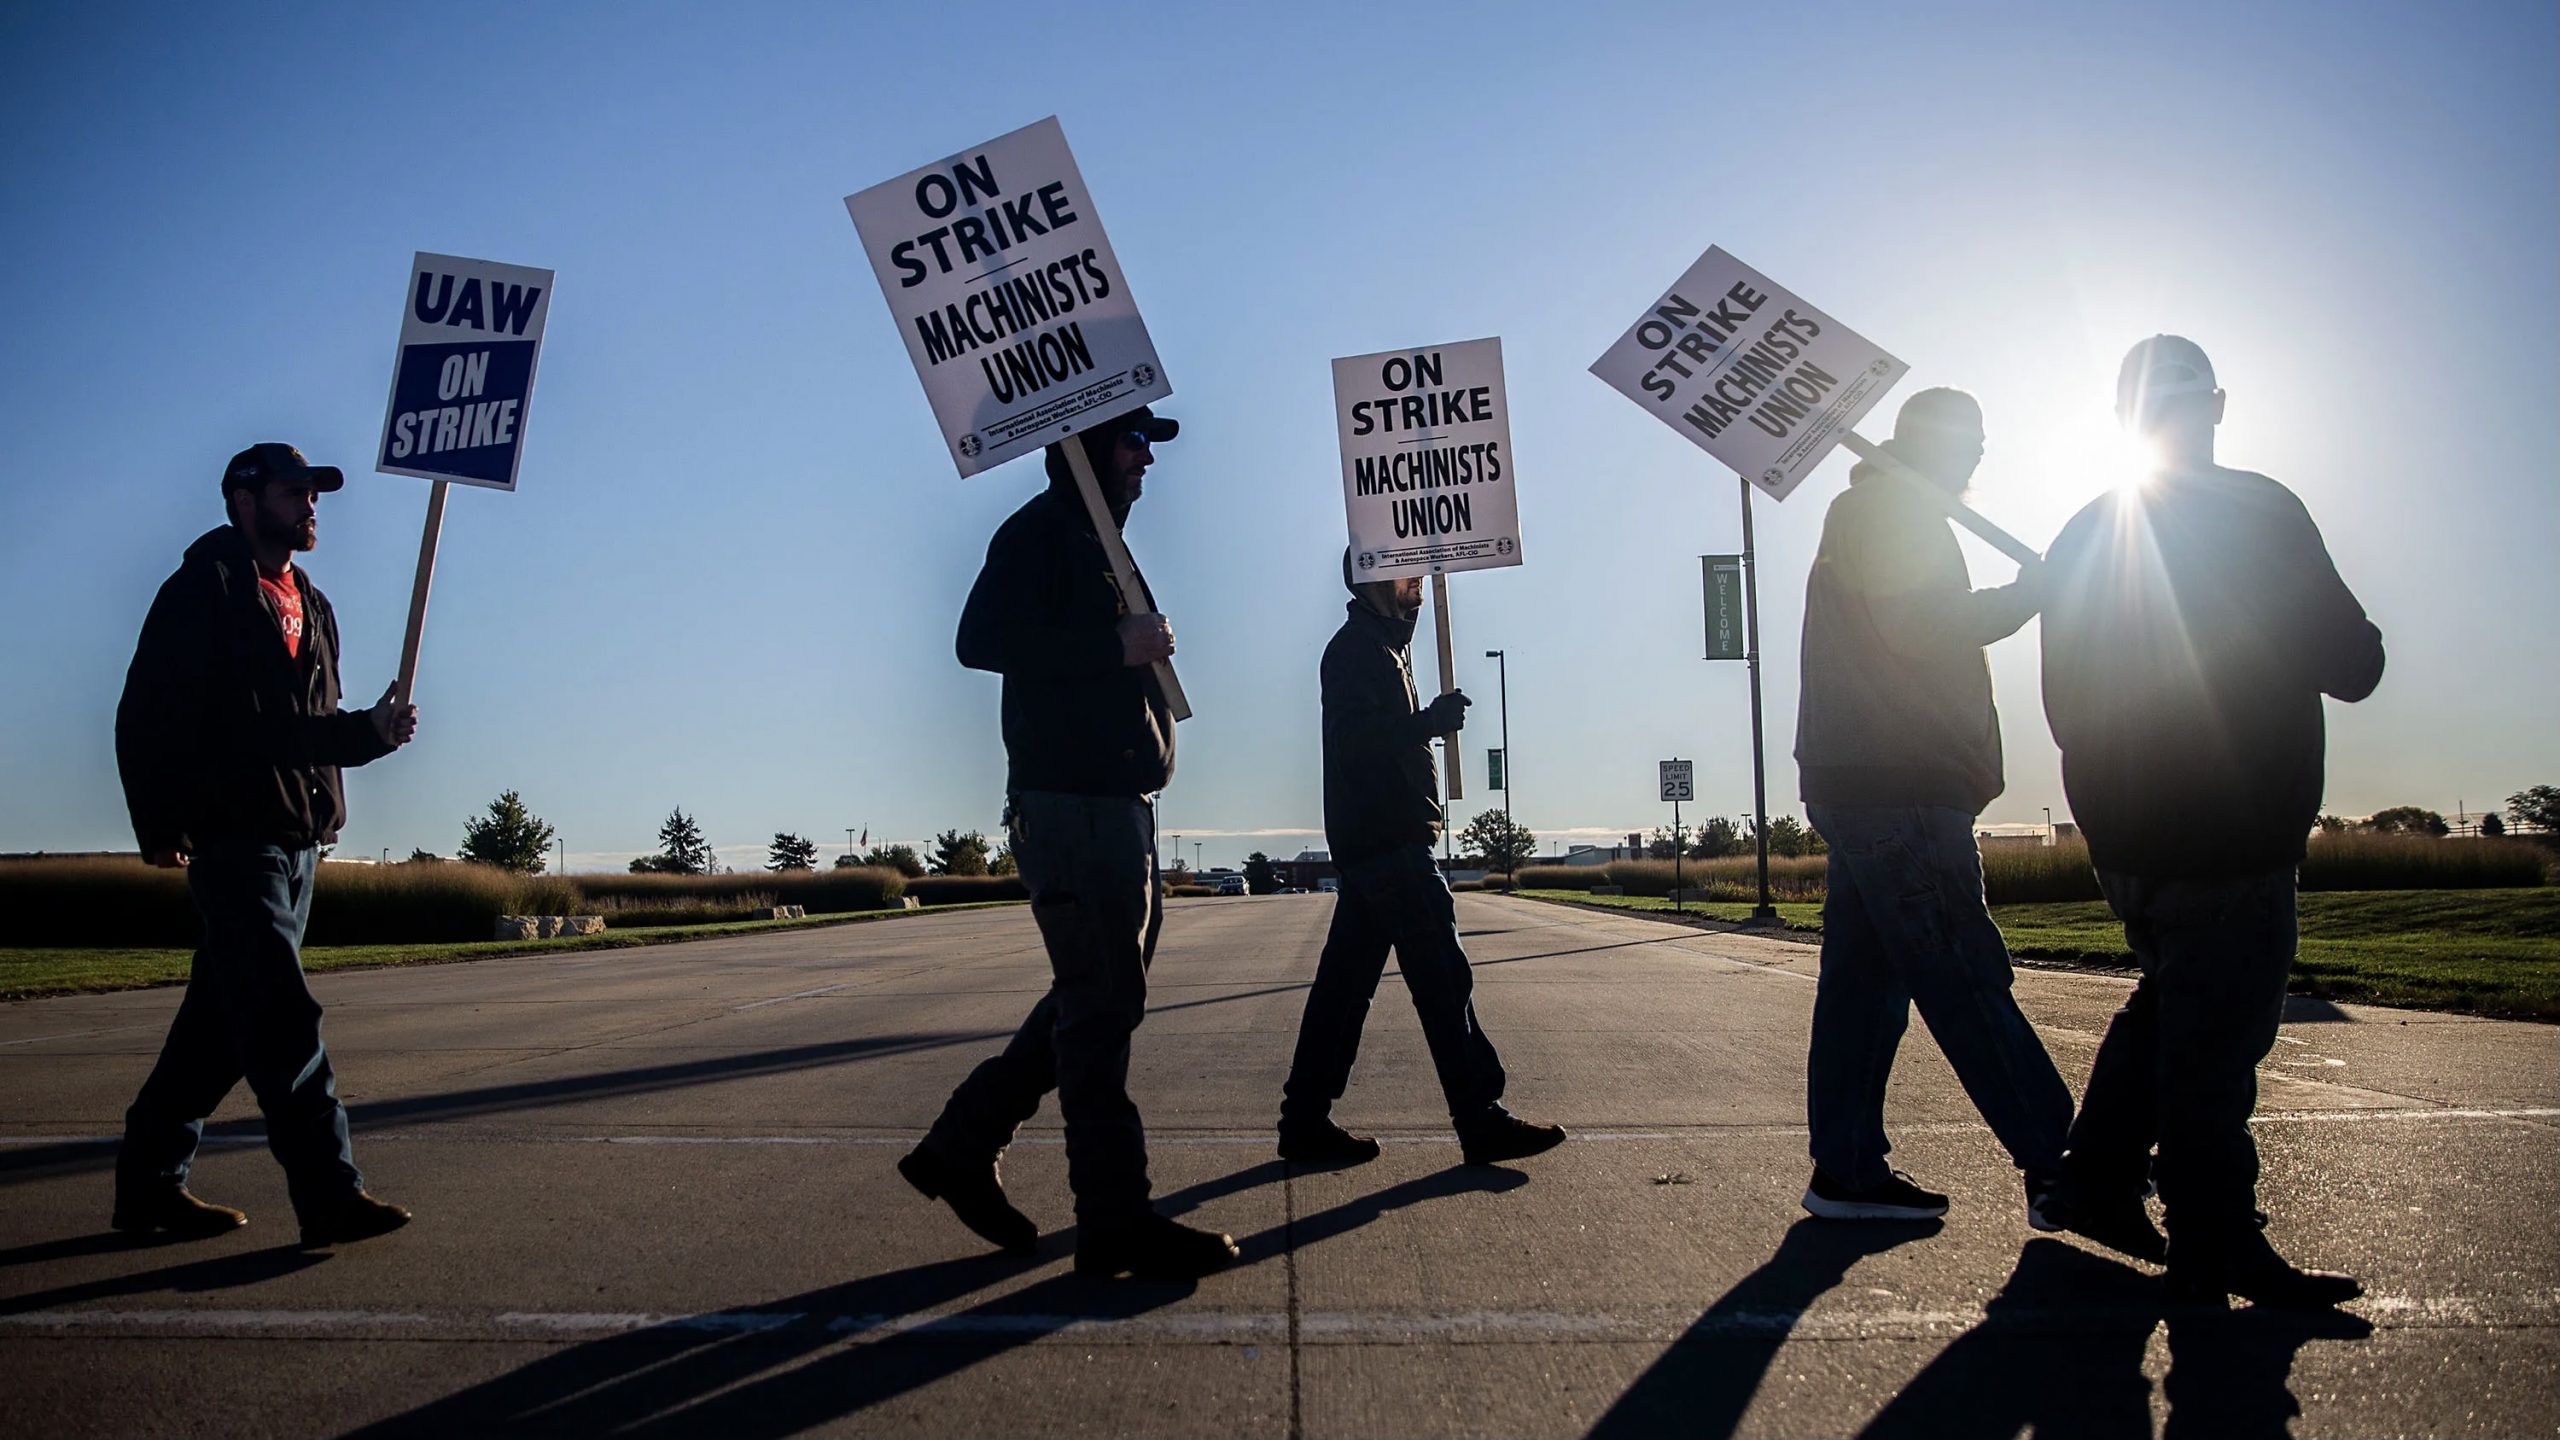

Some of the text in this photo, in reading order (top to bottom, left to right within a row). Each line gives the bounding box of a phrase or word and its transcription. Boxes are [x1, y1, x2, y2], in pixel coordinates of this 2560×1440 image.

[915, 154, 1001, 219] ON
[890, 180, 1078, 288] STRIKE
[414, 271, 542, 336] UAW
[914, 248, 1111, 366] MACHINISTS
[1636, 294, 1701, 350] ON
[980, 321, 1095, 405] UNION
[1640, 280, 1768, 402] STRIKE
[438, 351, 490, 401] ON
[1381, 353, 1443, 391] ON
[1682, 308, 1821, 440] MACHINISTS
[1747, 360, 1839, 438] UNION
[391, 398, 518, 459] STRIKE
[988, 378, 1124, 437] International Association of Machinists
[1015, 416, 1051, 437] Aerospace
[1084, 391, 1112, 408] AFL-CIO
[1351, 386, 1493, 436] STRIKE
[1355, 442, 1501, 497] MACHINISTS
[1392, 493, 1472, 539] UNION
[1381, 550, 1419, 559] International
[1419, 547, 1452, 555] Association
[1459, 542, 1490, 551] Machinists
[1717, 573, 1730, 651] WELCOME
[1664, 782, 1690, 796] 25
